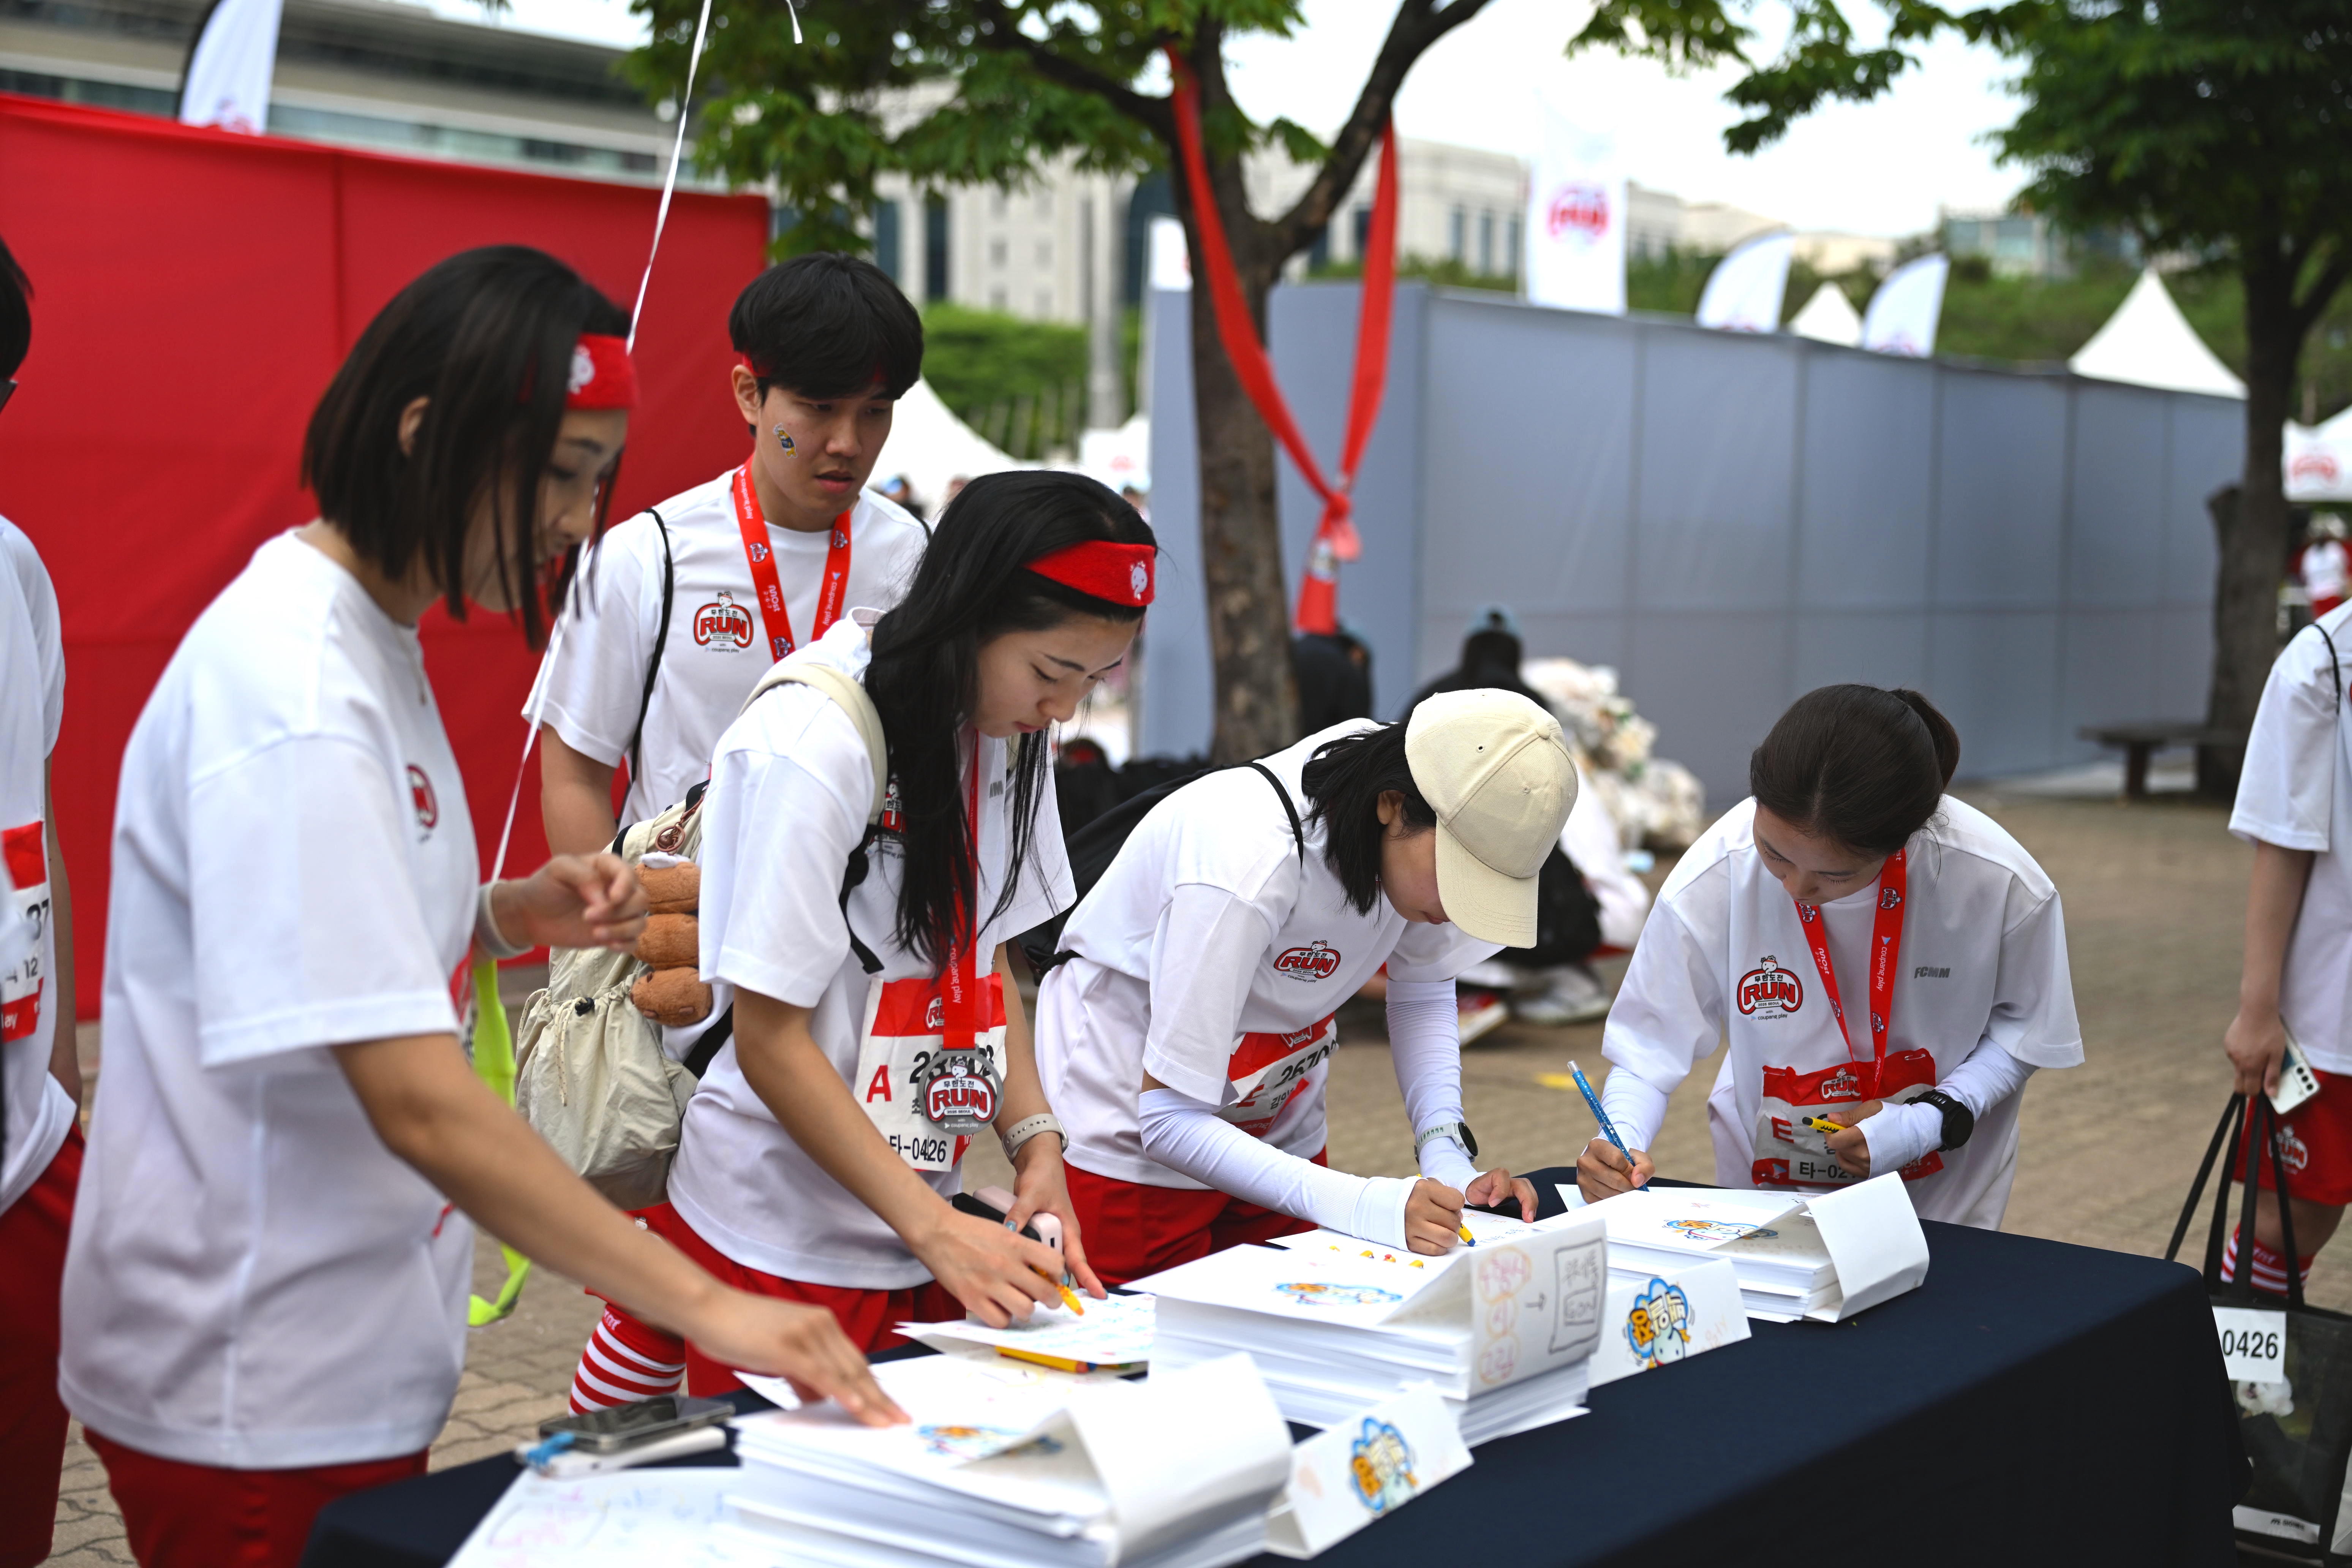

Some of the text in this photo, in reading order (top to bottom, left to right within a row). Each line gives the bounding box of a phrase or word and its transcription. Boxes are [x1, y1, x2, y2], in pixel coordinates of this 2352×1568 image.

[741, 479, 754, 519] coupang play
[768, 585, 781, 612] most
[822, 582, 837, 626] coupang play
[700, 616, 748, 640] RUN
[1280, 956, 1335, 973] RUN
[1818, 948, 1830, 975] most
[1876, 947, 1887, 992] coupang play
[1914, 966, 1951, 979] FCMM
[1755, 974, 1783, 983] 무한도전
[951, 985, 963, 1004] play
[1744, 982, 1796, 1005] RUN
[867, 1065, 891, 1103] A
[1823, 1080, 1858, 1095] RUN
[933, 1088, 988, 1113] RUN
[1771, 1116, 1794, 1143] E
[2222, 1329, 2278, 1359] 0426
